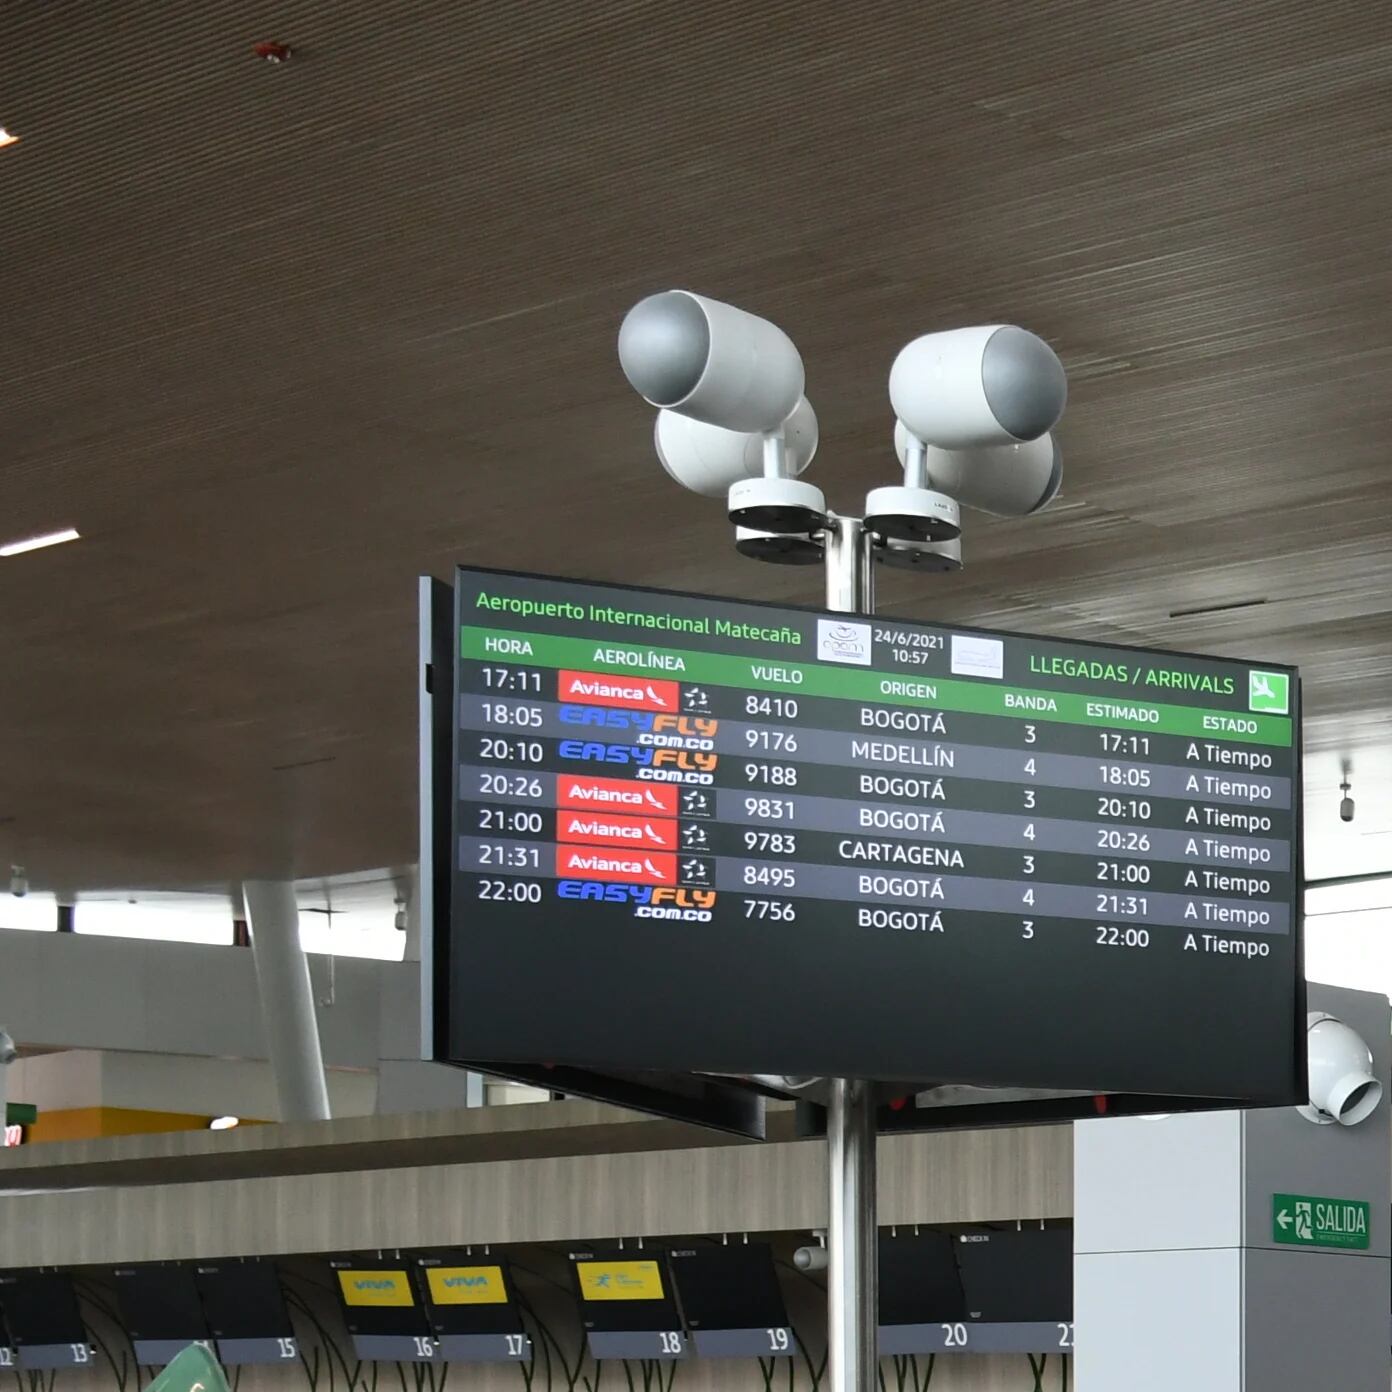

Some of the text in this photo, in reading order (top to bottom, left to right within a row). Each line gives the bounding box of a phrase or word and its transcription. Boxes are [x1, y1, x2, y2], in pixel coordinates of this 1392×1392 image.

[476, 592, 801, 645] Aeropuerto Internacional Matecaña
[874, 629, 944, 650] 24/6/2021
[892, 649, 929, 665] 10:57
[485, 637, 1258, 734] HORA AEROLÍNEA VUELO ORIGEN BANDA ESTIMADO ESTADO
[1029, 655, 1128, 682] LLEGADAS
[1145, 668, 1235, 695] ARRIVALS
[481, 668, 1272, 770] 17:11 Avianca 8410 BOGOTÁ 3 17:11 A Tiempo
[481, 703, 543, 728] 18:05
[746, 729, 798, 753] 9176
[851, 740, 955, 768] MEDELLÍN
[1024, 758, 1036, 776] 4
[1099, 766, 1151, 788] 18:05
[1185, 775, 1199, 793] A
[1203, 776, 1272, 800] Tiempo
[479, 738, 543, 764] 20:10
[744, 764, 798, 787] 9188
[859, 775, 946, 802] BOGOTÁ
[1023, 791, 1036, 809] 3
[1098, 798, 1151, 820] 20:10
[1185, 807, 1199, 825] A
[1203, 808, 1272, 832] Tiempo
[479, 774, 1271, 864] 20:26 Avianca 9831 BOGOTÁ 4 20:26 A Tiempo
[479, 809, 1271, 895] 21:00 Avianca 9783 CARTAGENA 3 21:00 A Tiempo
[478, 844, 1270, 927] 21:31 Avianca 8495 BOGOTÁ 4 21:31 A Tiempo
[478, 879, 542, 904] 22:00
[743, 900, 796, 923] 7756
[857, 908, 944, 934] BOGOTÁ
[1022, 921, 1034, 939] 3
[1096, 927, 1150, 948] 22:00
[1183, 934, 1198, 952] A
[1202, 935, 1270, 959] Tiempo
[1316, 1204, 1366, 1233] SALIDA
[277, 1338, 296, 1358] 15
[413, 1337, 433, 1356] 16
[505, 1335, 523, 1355] 17
[659, 1332, 681, 1353] 18
[767, 1328, 788, 1350] 19
[942, 1323, 967, 1346] 20
[71, 1343, 88, 1362] 13
